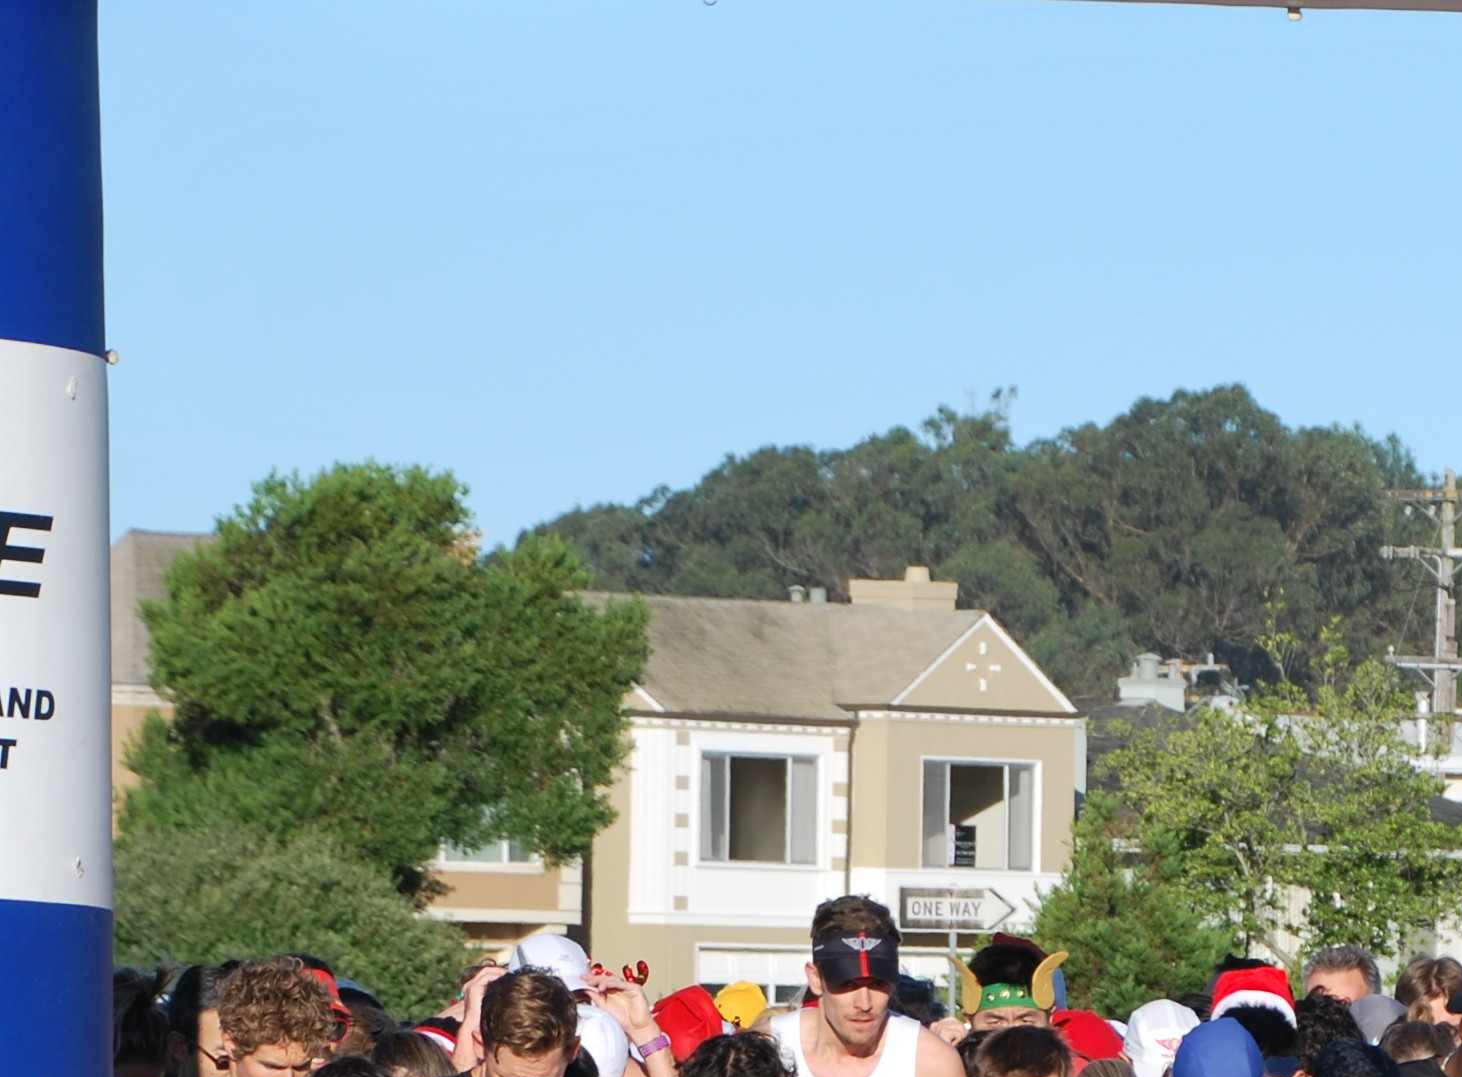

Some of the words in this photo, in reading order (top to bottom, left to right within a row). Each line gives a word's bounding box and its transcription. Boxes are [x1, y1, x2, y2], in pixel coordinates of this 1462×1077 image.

[0, 686, 55, 721] ND
[911, 901, 945, 917] ONE
[949, 900, 982, 917] WAY
